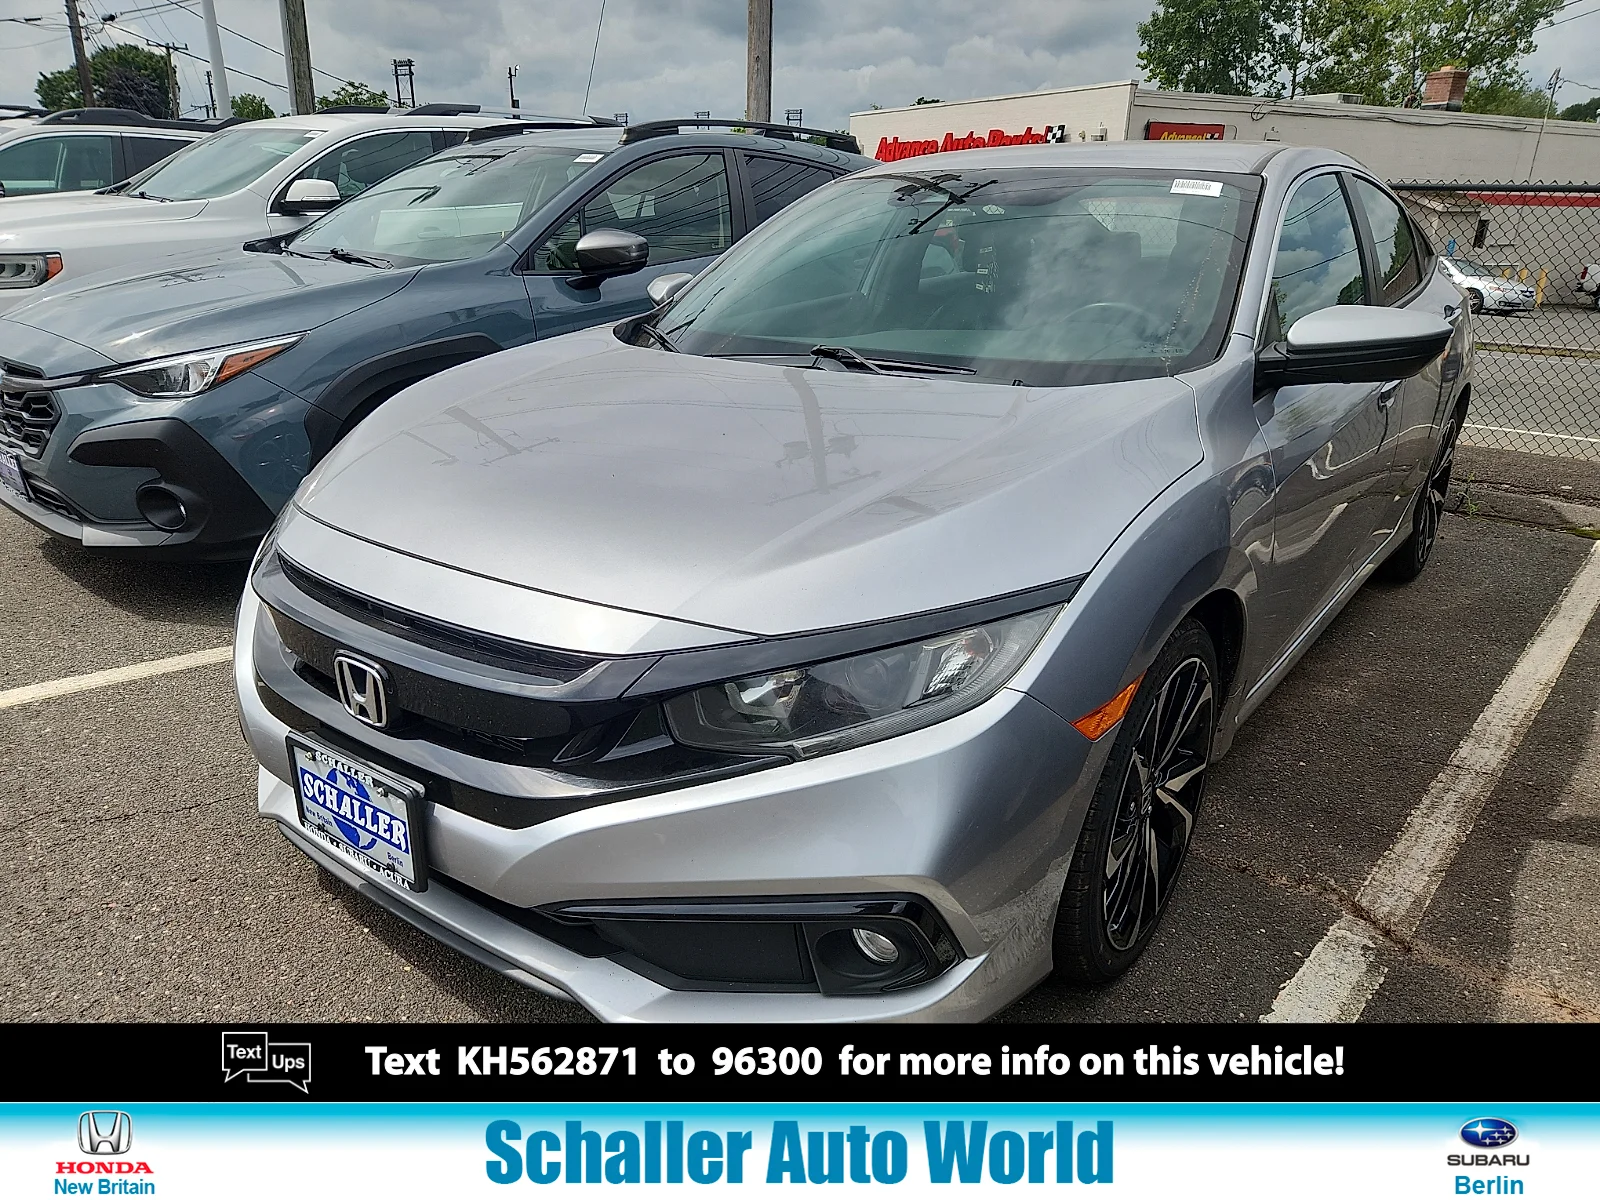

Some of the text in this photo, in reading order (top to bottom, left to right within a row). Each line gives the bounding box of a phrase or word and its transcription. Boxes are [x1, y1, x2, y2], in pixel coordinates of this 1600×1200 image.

[875, 136, 938, 162] Advance
[940, 131, 985, 152] Auto
[314, 751, 374, 788] SCHALLER
[303, 773, 406, 851] SCHALLER
[386, 851, 404, 868] Berlin
[380, 866, 410, 891] ACURA
